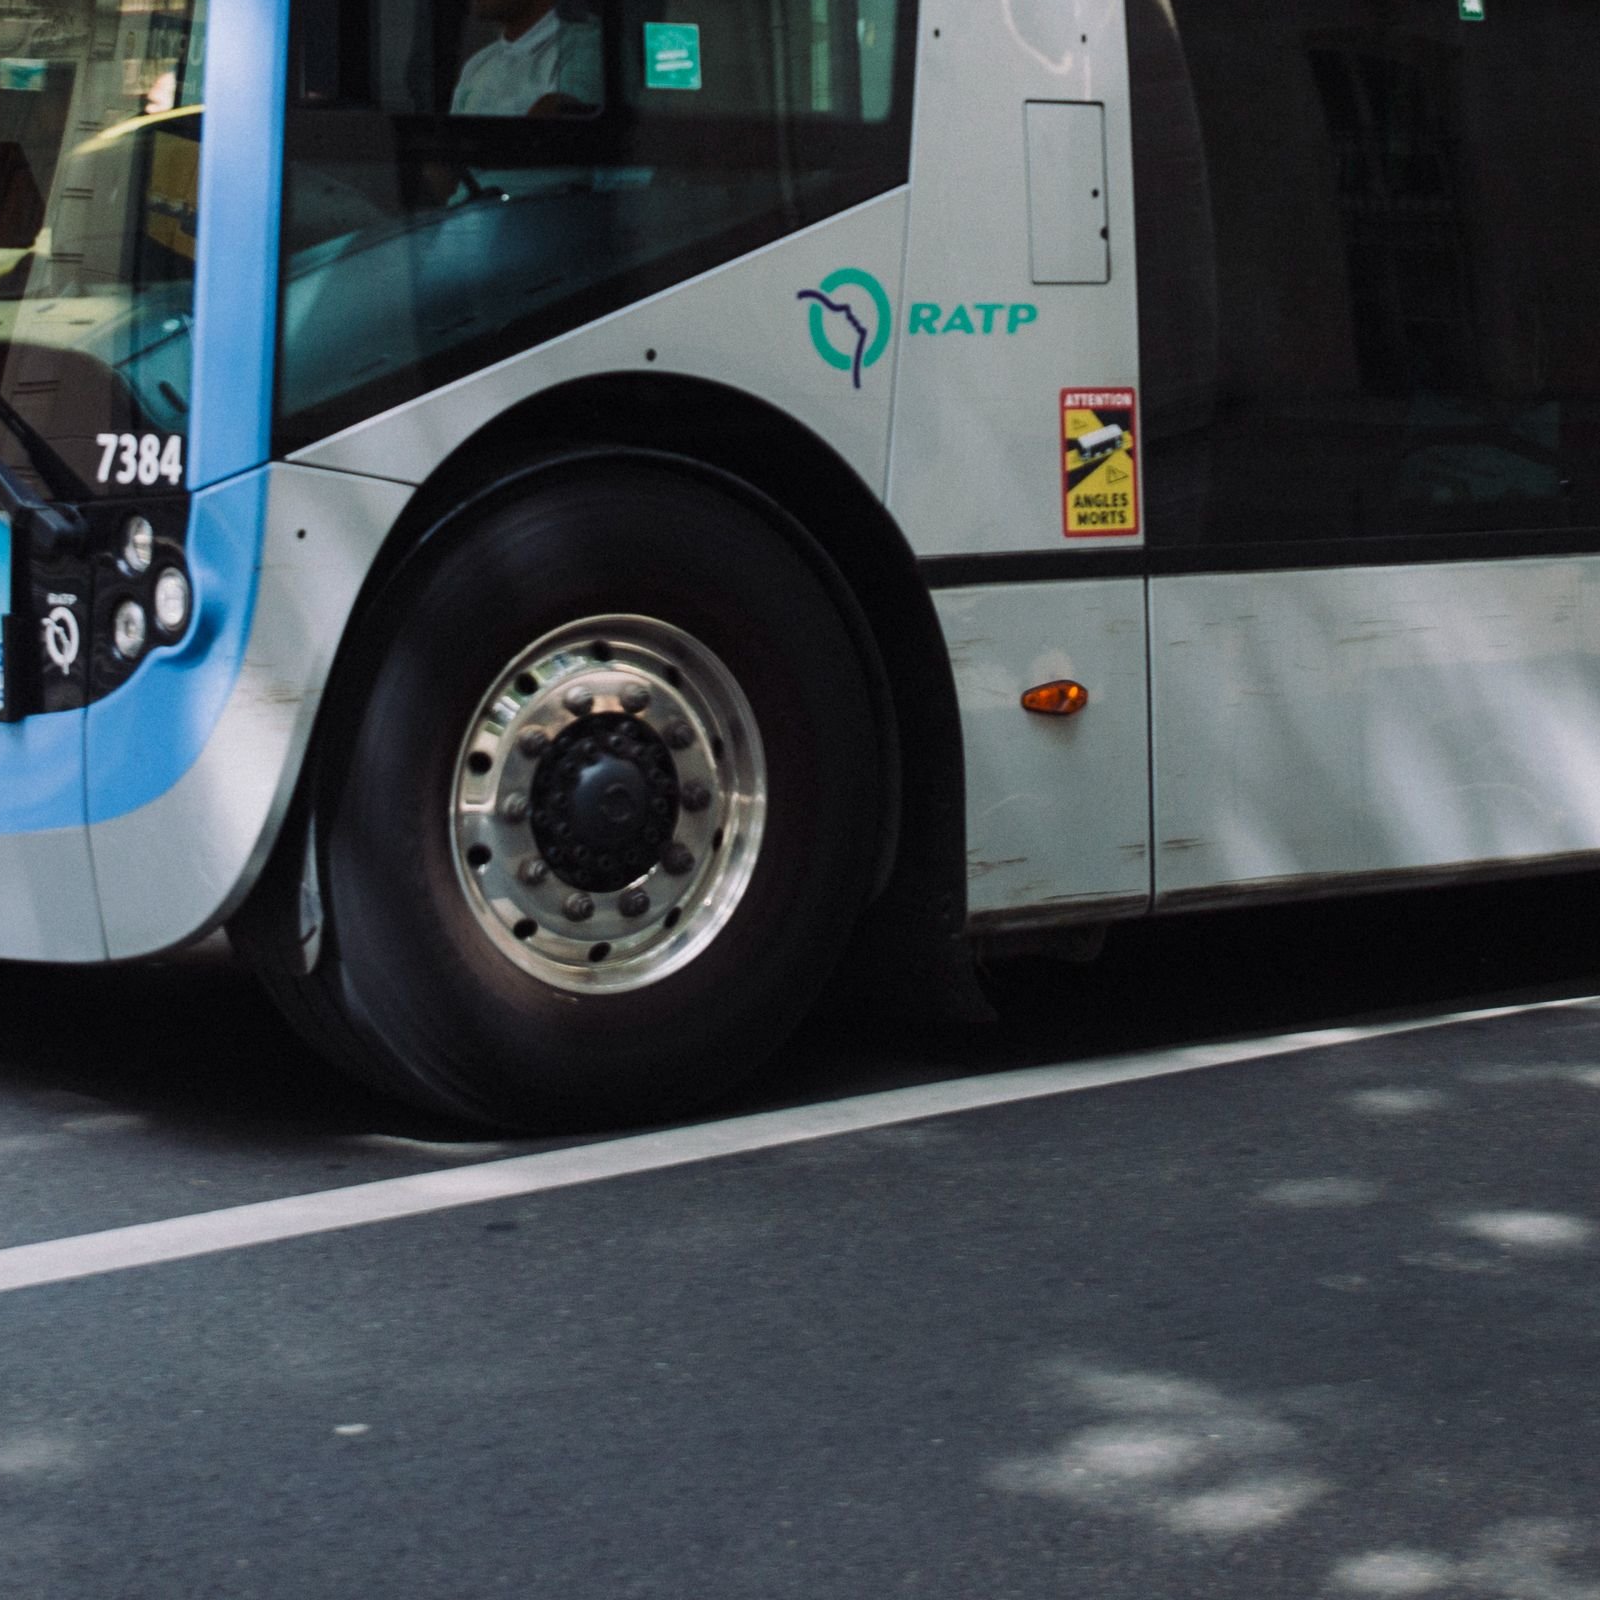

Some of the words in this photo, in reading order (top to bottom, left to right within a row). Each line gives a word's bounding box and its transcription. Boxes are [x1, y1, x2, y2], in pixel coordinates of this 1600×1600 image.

[908, 302, 1039, 336] RATP
[1063, 392, 1133, 408] ATTENTION
[96, 431, 183, 487] 7384
[1073, 492, 1130, 510] ANGLES
[1076, 509, 1128, 526] MORTS
